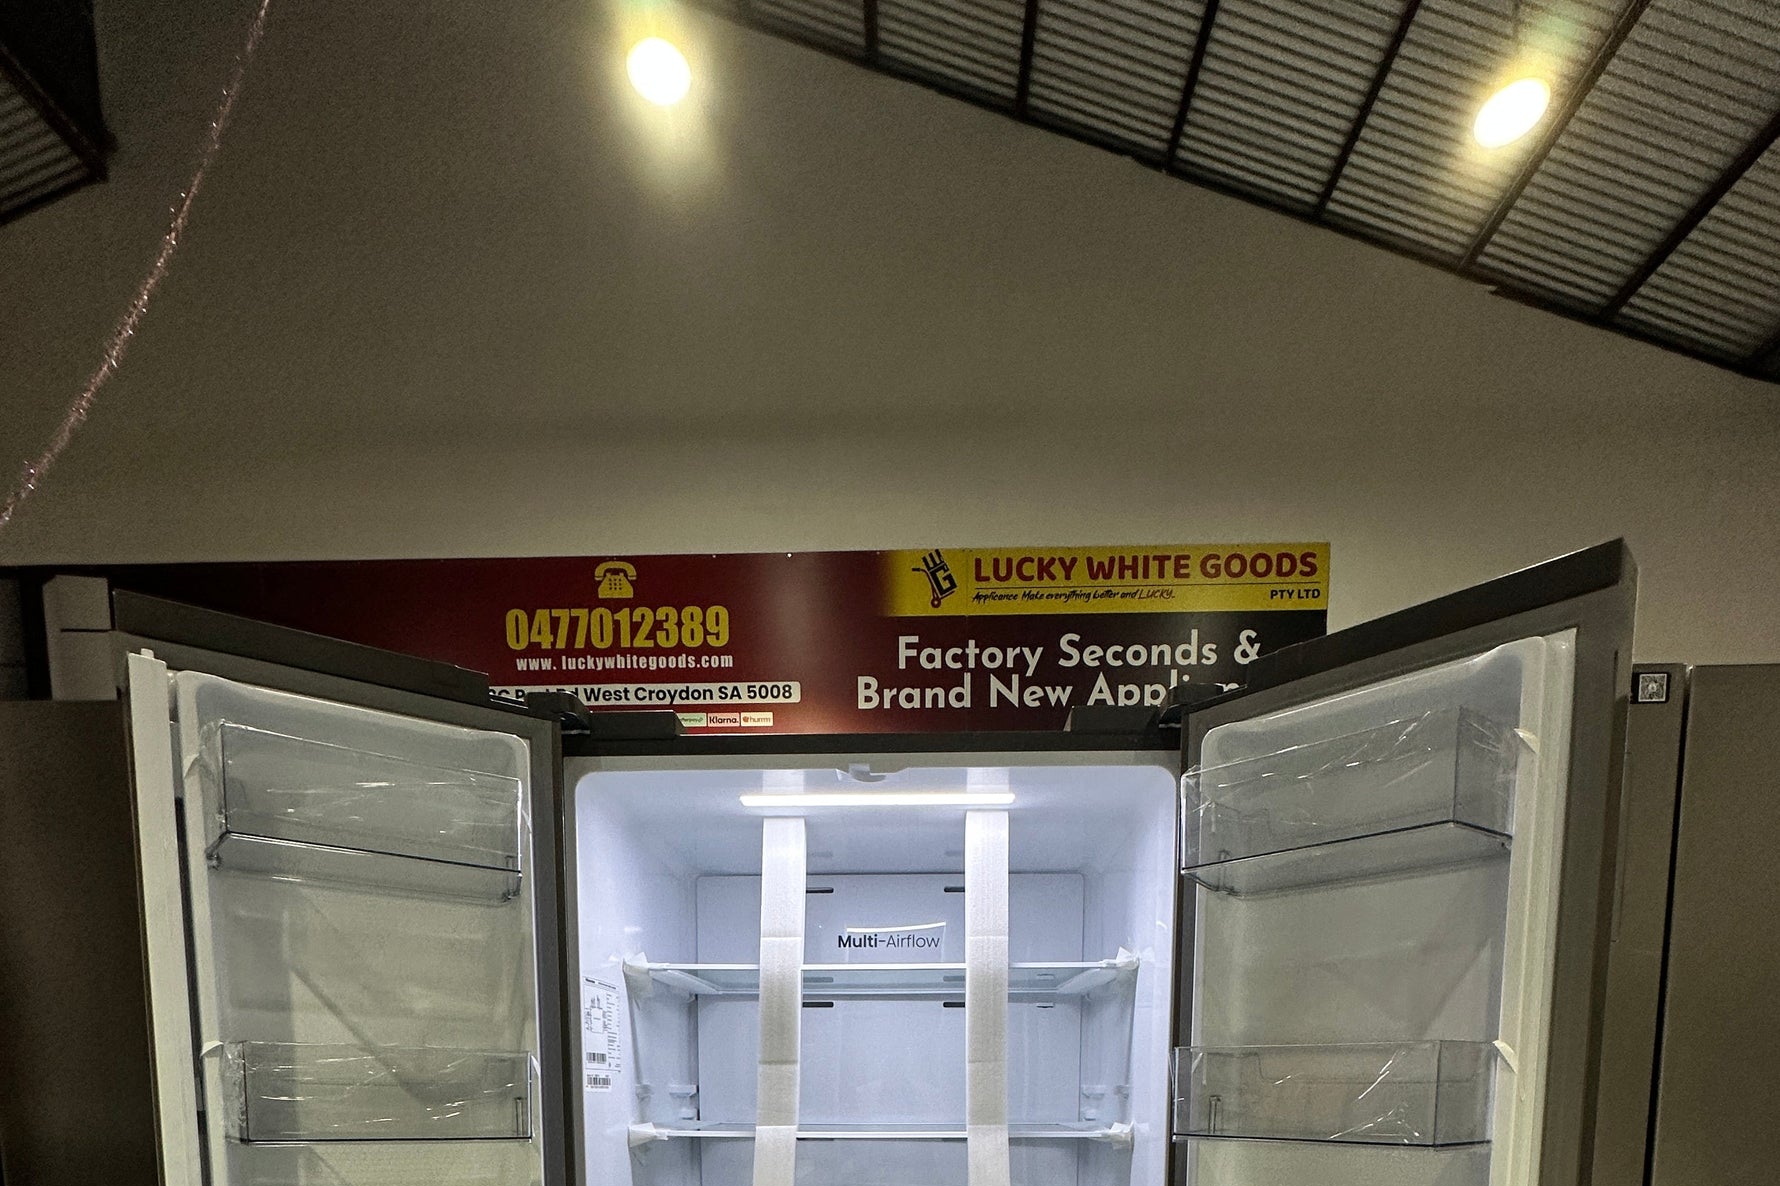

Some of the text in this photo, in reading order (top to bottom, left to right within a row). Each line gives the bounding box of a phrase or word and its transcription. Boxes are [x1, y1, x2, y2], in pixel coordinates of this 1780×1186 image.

[974, 551, 1318, 582] LUCKY WHITE GOODS
[1021, 589, 1044, 602] Make
[1045, 588, 1092, 603] everything
[1093, 589, 1119, 600] better
[1120, 588, 1138, 599] and
[1270, 588, 1321, 600] PTY LTD
[505, 605, 729, 650] 0477012389
[516, 653, 734, 671] www. luckywhitegoods.com
[898, 628, 1261, 677] Factory Seconds &
[583, 686, 630, 701] West
[634, 685, 713, 705] Croydon
[718, 685, 742, 700] SA
[747, 684, 792, 699] 5008
[857, 672, 971, 710] Brand
[989, 673, 1073, 708] New
[837, 933, 940, 948] Multi-Airflow
